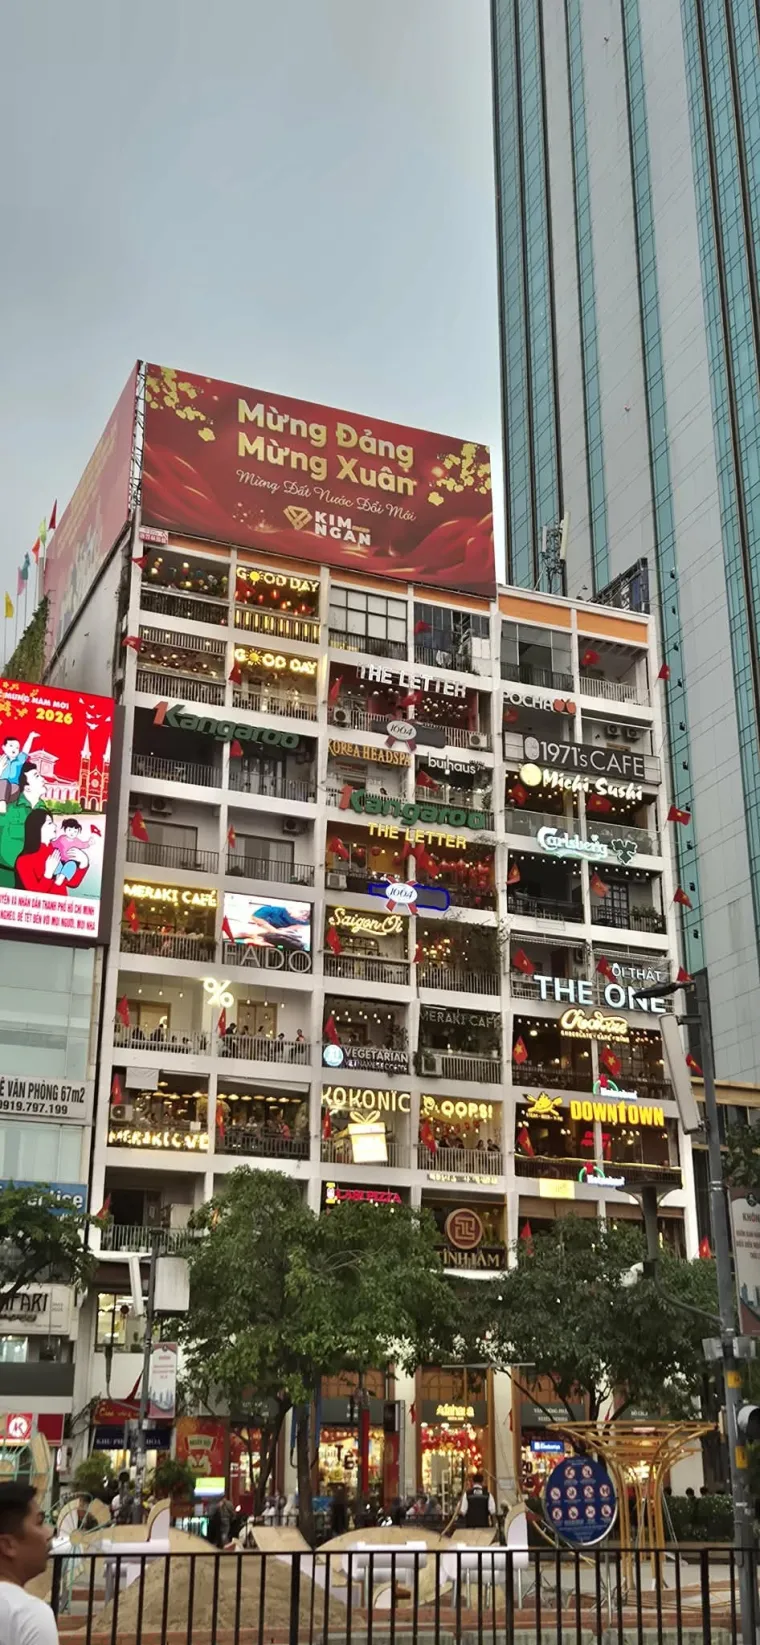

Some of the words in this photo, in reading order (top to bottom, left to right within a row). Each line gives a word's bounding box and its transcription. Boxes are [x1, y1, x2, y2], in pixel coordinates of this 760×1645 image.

[238, 398, 327, 446] Mừng
[336, 421, 414, 468] Đảng
[238, 431, 327, 481] Mừng
[337, 455, 416, 496] Xuân
[315, 511, 352, 529] KIM
[290, 578, 319, 592] DAY
[290, 659, 317, 674] DAY
[357, 663, 392, 685] THE
[399, 670, 467, 698] LETTER
[36, 708, 73, 725] 2026
[152, 701, 300, 749] Kangaroo
[390, 723, 413, 736] 1664
[328, 739, 360, 757] KOREA
[363, 744, 412, 766] HEADSPA
[590, 751, 644, 777] CAFE
[595, 778, 643, 800] Sushi
[339, 784, 485, 829] Kangaroo
[368, 822, 399, 839] THE
[405, 828, 467, 850] LETTER
[537, 826, 608, 857] Carlsberg
[123, 884, 179, 903] MERAKI
[389, 886, 414, 899] 1664
[329, 908, 385, 936] Saigon
[533, 974, 593, 1006] THE
[604, 983, 666, 1013] ONE
[420, 1009, 466, 1025] MERAKI
[344, 1047, 409, 1063] VEGETARIAN
[8, 1080, 26, 1098] VĂN
[28, 1080, 59, 1100] PHÒNG
[61, 1085, 85, 1103] 67m2
[570, 1099, 664, 1127] DOWNTOWN
[108, 1130, 170, 1147] MERAKI
